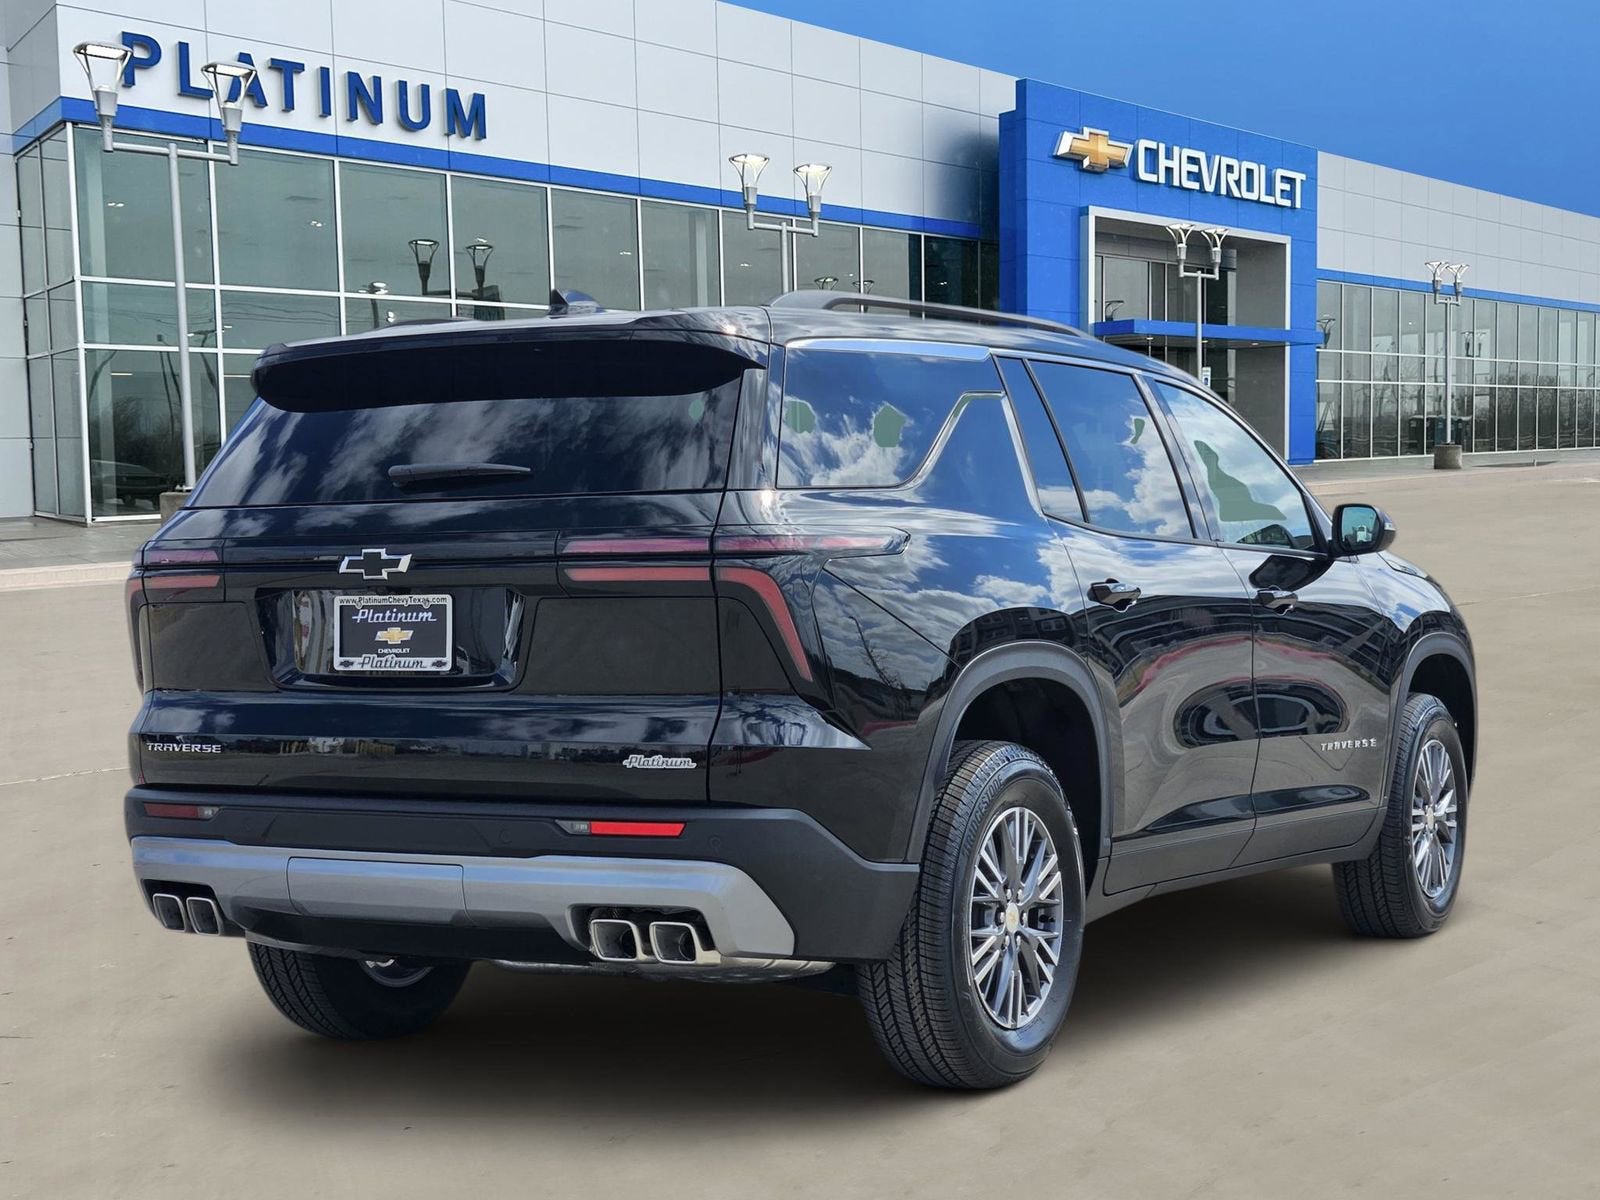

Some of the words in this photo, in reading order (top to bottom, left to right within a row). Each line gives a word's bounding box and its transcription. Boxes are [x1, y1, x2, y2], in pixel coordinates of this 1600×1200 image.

[121, 31, 487, 140] PLATINUM
[1136, 139, 1307, 209] CHEVROLET
[352, 608, 437, 623] Platinum
[358, 655, 428, 669] Platinum
[145, 742, 222, 753] TRAVERSE
[1320, 737, 1377, 751] TRAVERSE
[623, 754, 697, 768] Platinum
